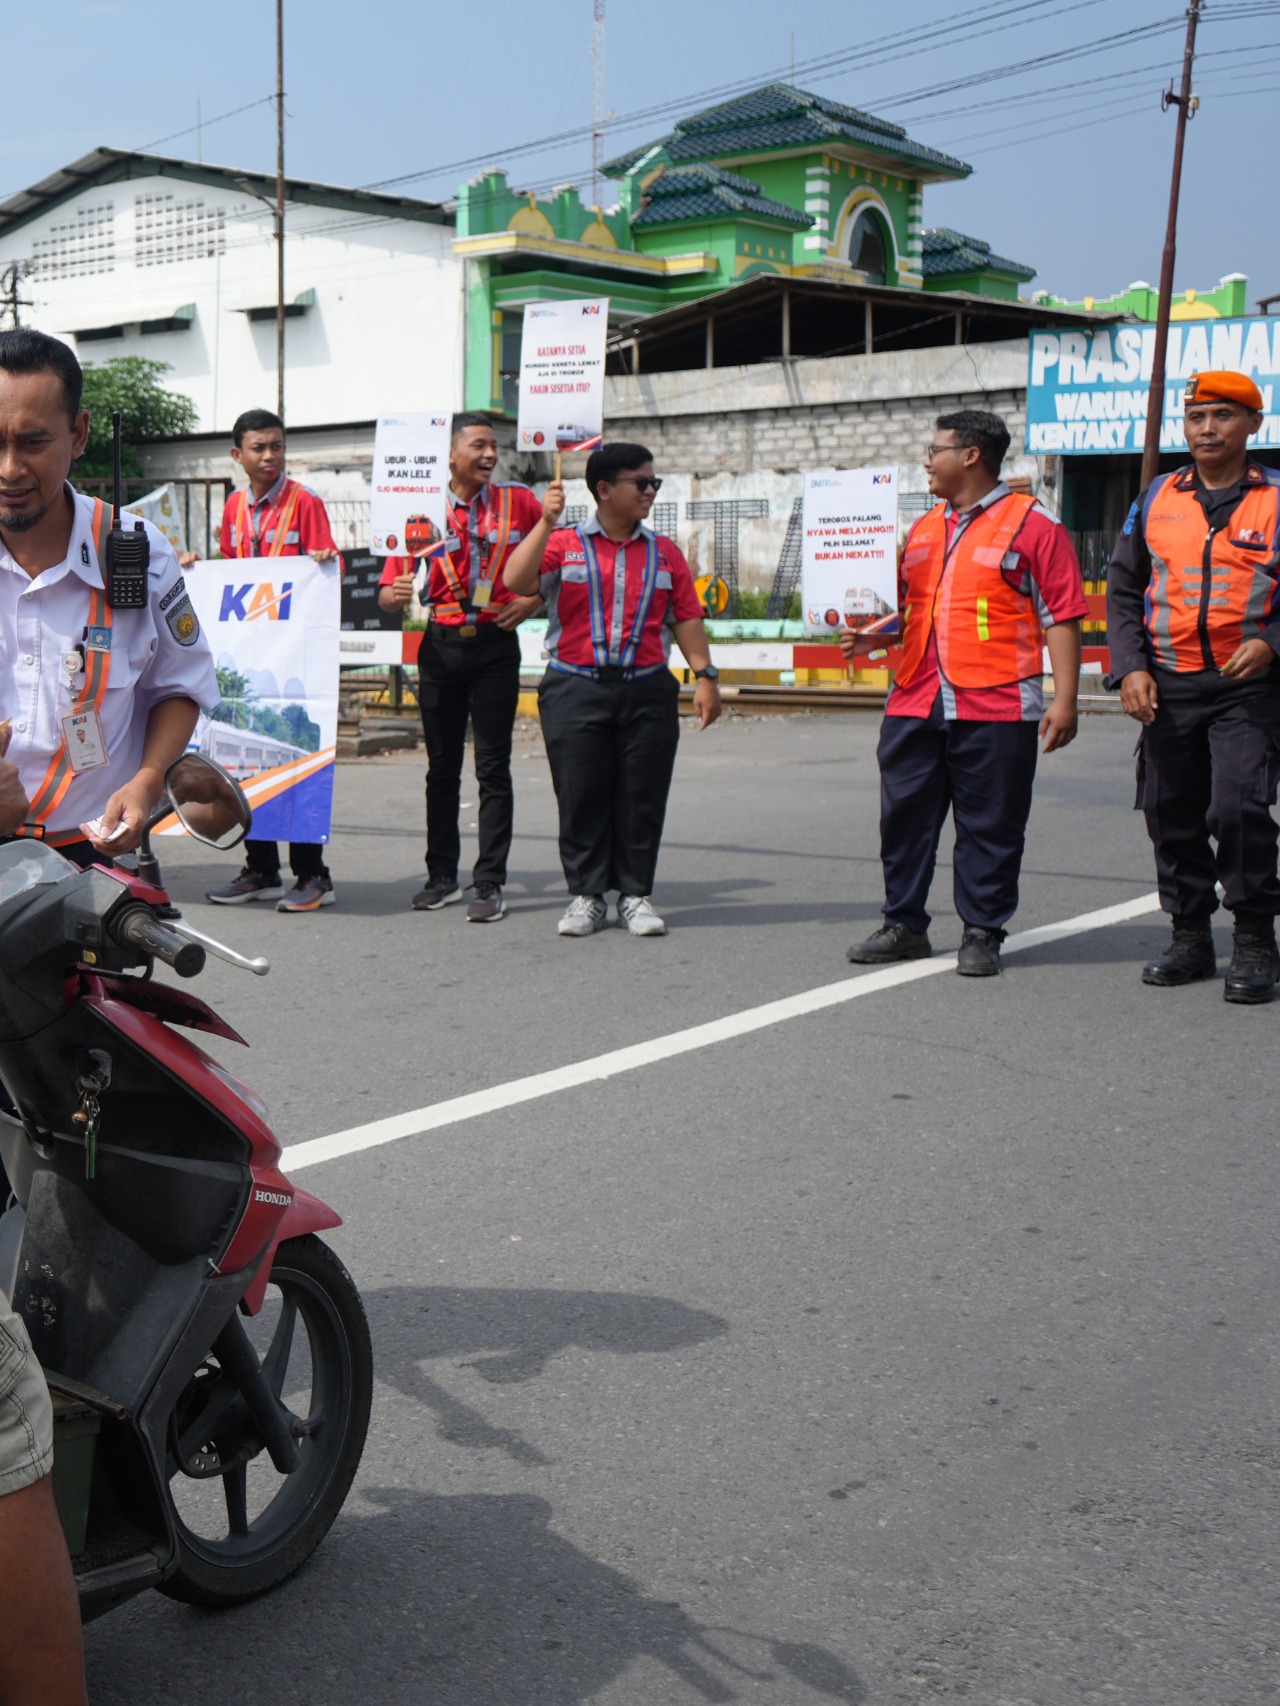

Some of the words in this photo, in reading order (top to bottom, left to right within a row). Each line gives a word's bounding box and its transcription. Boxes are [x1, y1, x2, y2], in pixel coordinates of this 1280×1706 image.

[582, 305, 600, 315] KAI
[537, 345, 567, 357] KATANYA
[568, 345, 586, 356] SETIA
[1031, 321, 1280, 386] PRASMANA
[525, 361, 550, 369] NUNGGU
[552, 360, 576, 368] KERETA
[530, 383, 549, 394] YAKIN
[550, 383, 574, 394] SESETIA
[576, 382, 591, 393] ITU?
[1029, 420, 1132, 450] KENTAKY
[385, 456, 407, 464] UBUR
[414, 456, 437, 464] UBUR
[388, 470, 408, 478] IKAN
[410, 470, 432, 478] LELE
[872, 474, 891, 484] KAI
[818, 516, 851, 524] TEROBOS
[852, 514, 882, 522] PALANG
[807, 527, 837, 537] NYAWA
[839, 525, 894, 536] MELAYANG!!!
[842, 539, 875, 547] SELAMAT
[815, 551, 844, 561] BUKAN
[846, 550, 885, 559] NEKAT!!!
[218, 582, 293, 621] KAI
[72, 716, 87, 726] KAI
[255, 1190, 292, 1206] HONDA
